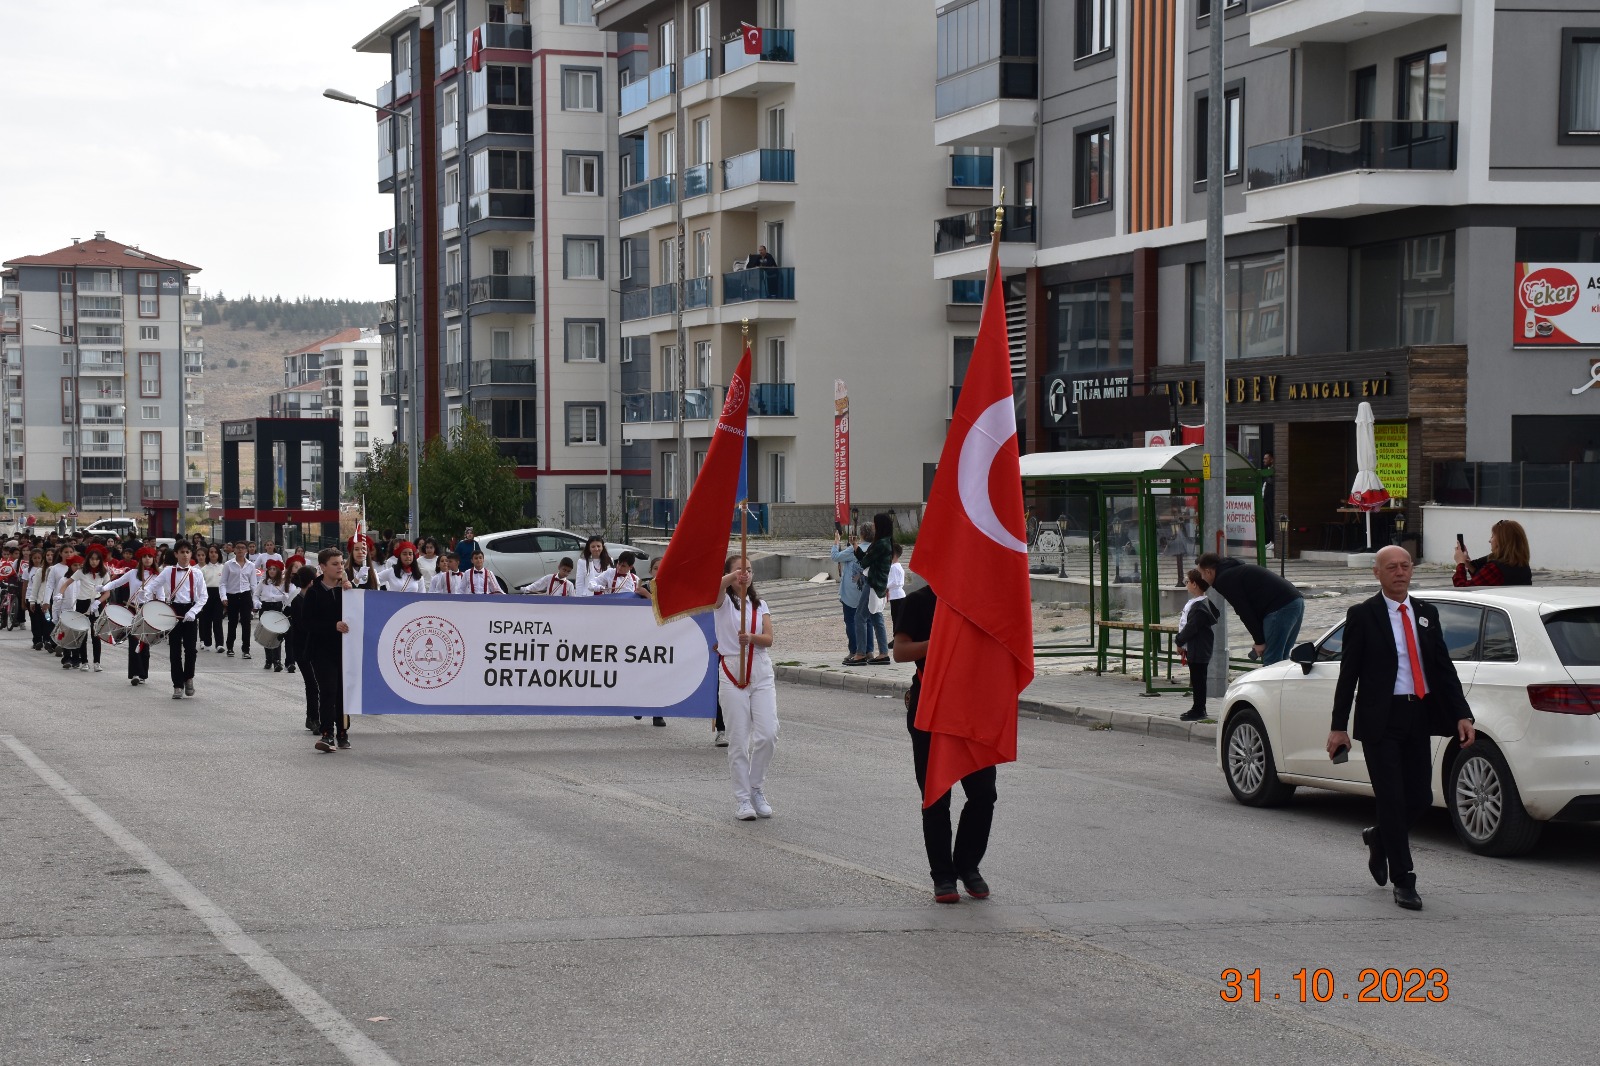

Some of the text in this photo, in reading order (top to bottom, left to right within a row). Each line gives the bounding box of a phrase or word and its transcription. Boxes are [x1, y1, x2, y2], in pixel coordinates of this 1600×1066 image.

[1532, 285, 1577, 306] eker
[1164, 372, 1387, 406] ASLNBEY MANGAL EVİ
[489, 620, 553, 635] ISPARTA
[484, 639, 674, 664] ŞEHİT ÖMER SARI
[483, 668, 618, 688] ORTAOKULU
